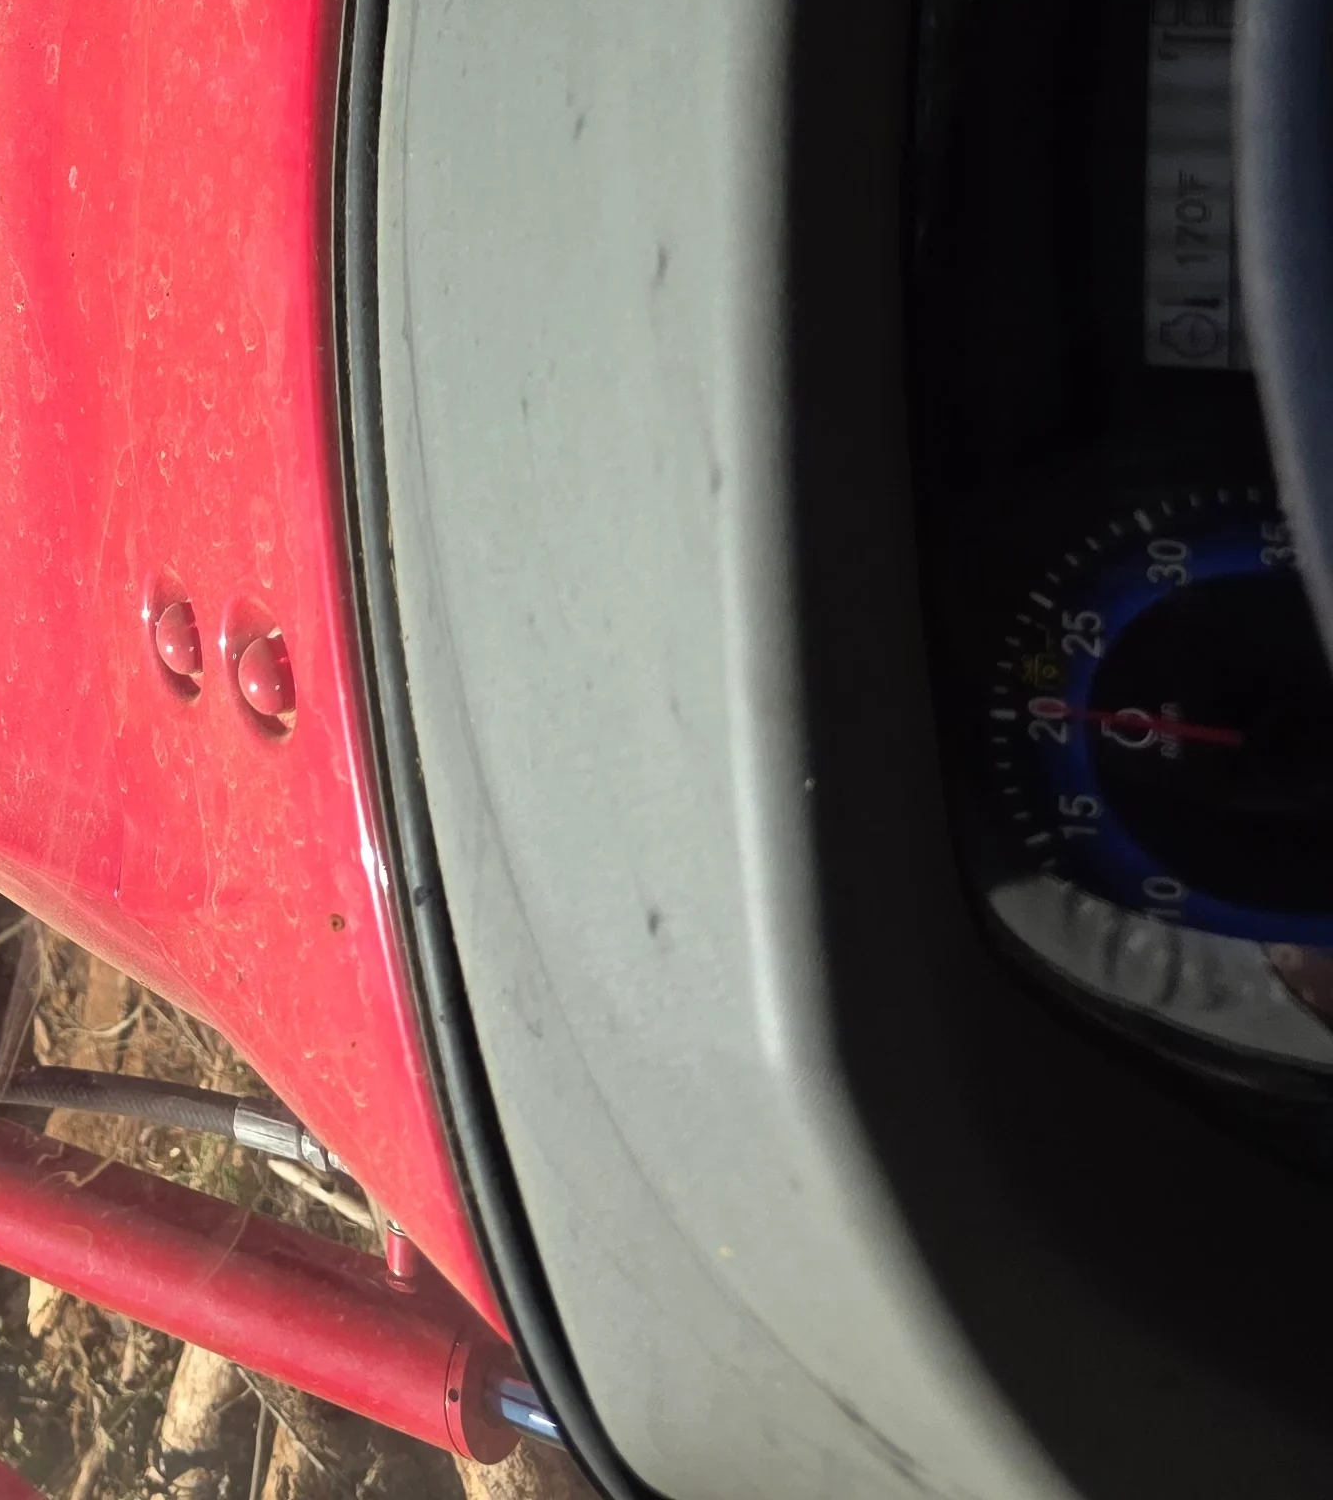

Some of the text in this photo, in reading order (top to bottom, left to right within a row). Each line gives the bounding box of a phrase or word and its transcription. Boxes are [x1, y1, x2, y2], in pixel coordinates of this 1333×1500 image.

[1145, 537, 1191, 587] 30
[1061, 608, 1103, 659] 25
[1027, 695, 1068, 746] 20
[1058, 792, 1101, 839] 15
[1141, 874, 1188, 920] 10
